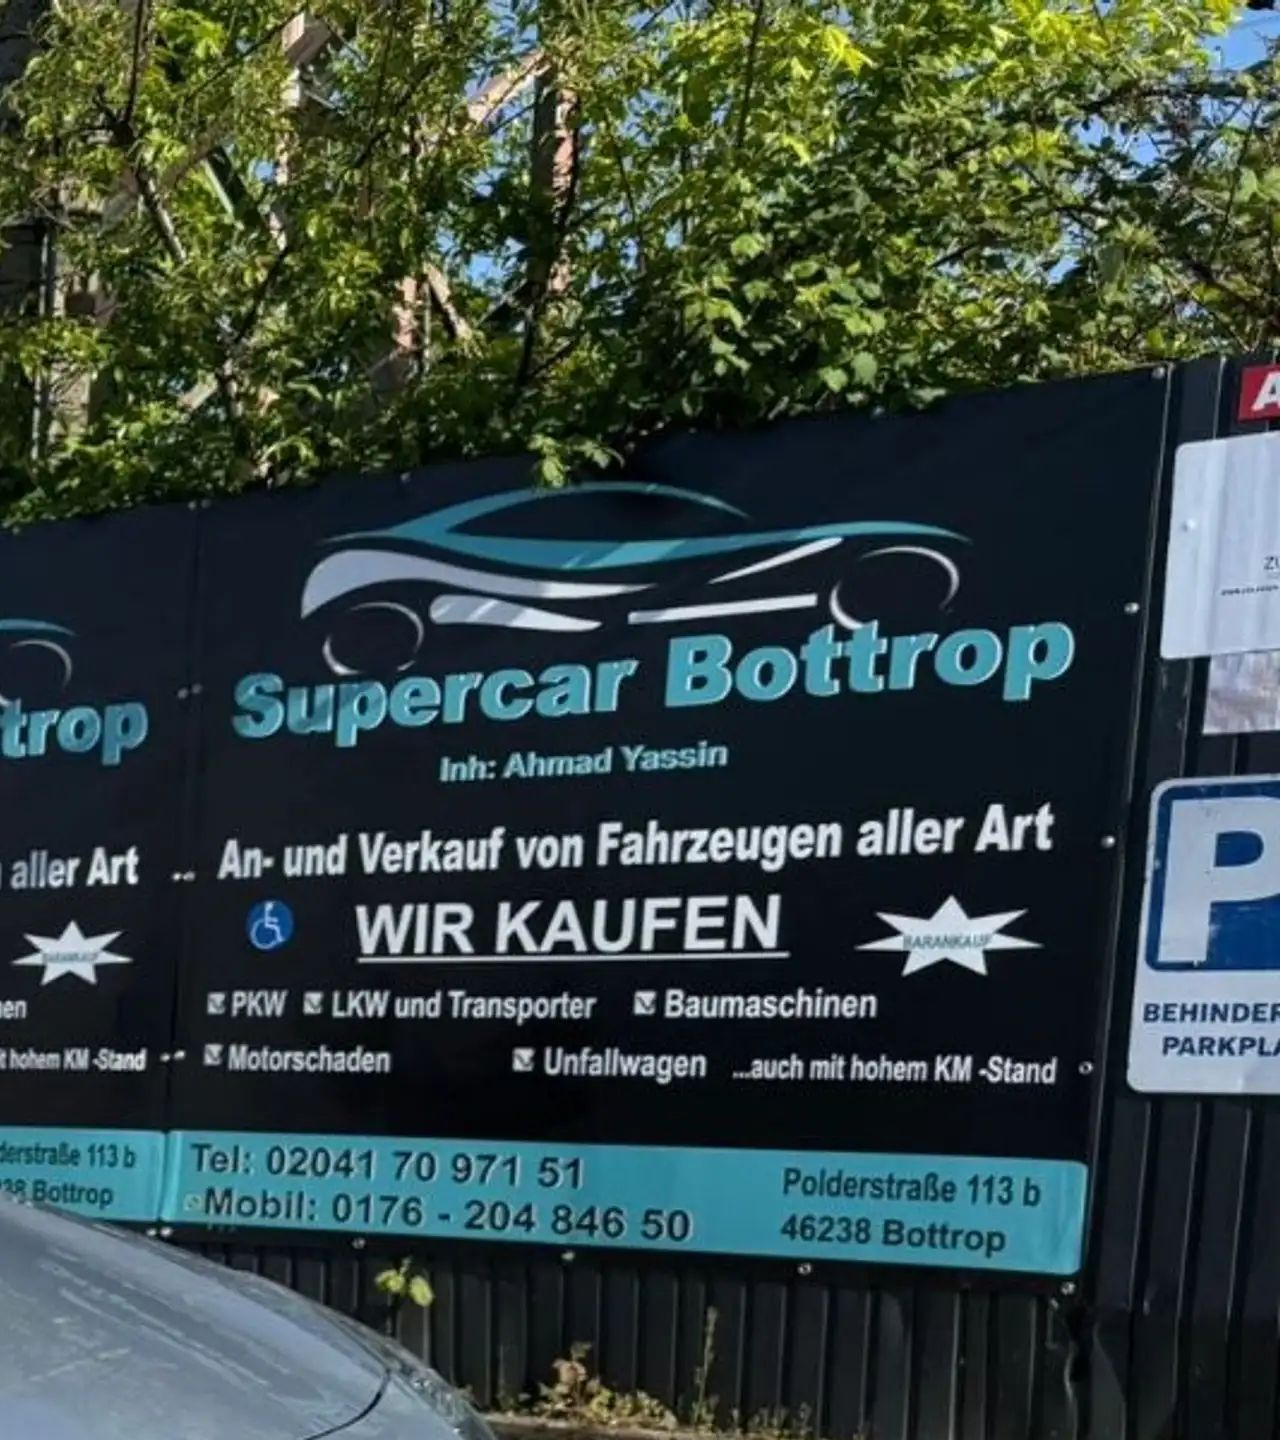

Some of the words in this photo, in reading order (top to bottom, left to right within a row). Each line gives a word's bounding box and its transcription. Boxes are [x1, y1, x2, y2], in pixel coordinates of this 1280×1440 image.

[232, 659, 639, 748] Supercar
[665, 619, 1075, 708] Bottrop
[439, 756, 496, 783] Inh:
[503, 746, 612, 779] Ahmad
[620, 740, 728, 772] Yassin
[217, 838, 274, 880] An-
[283, 833, 348, 877] und
[358, 826, 507, 873] Verkauf
[516, 833, 583, 869] von
[597, 811, 841, 872] Fahrzeugen
[856, 807, 966, 856] aller
[974, 801, 1056, 853] Art
[10, 850, 81, 889] aller
[86, 846, 139, 885] Art
[1157, 797, 1280, 963] P
[355, 903, 474, 955] WIR
[495, 893, 781, 954] KAUFEN
[231, 991, 287, 1017] PKW
[331, 992, 391, 1018] LKW
[394, 991, 441, 1018] und
[447, 991, 598, 1026] Transporter
[664, 987, 878, 1019] Baumaschinen
[9, 1048, 61, 1070] hohem
[63, 1049, 89, 1070] KM
[227, 1044, 391, 1073] Motorschaden
[543, 1048, 707, 1084] Unfallwagen
[732, 1054, 803, 1080] ...auch
[809, 1054, 845, 1081] mit
[850, 1054, 928, 1082] hohem
[933, 1055, 973, 1082] KM
[978, 1055, 1058, 1084] -Stand
[88, 1143, 117, 1168] 113
[123, 1148, 136, 1169] b
[190, 1142, 252, 1176] Tel:
[266, 1145, 375, 1180] 02041
[392, 1149, 436, 1183] 70
[450, 1152, 521, 1187] 971
[537, 1156, 584, 1190] 51
[32, 1180, 114, 1210] Bottrop
[782, 1167, 957, 1203] Polderstraße
[967, 1174, 1013, 1206] 113
[1023, 1177, 1041, 1206] b
[204, 1186, 316, 1222] Mobil:
[331, 1193, 423, 1227] 0176
[463, 1199, 536, 1233] 204
[550, 1204, 626, 1239] 846
[641, 1207, 691, 1242] 50
[781, 1214, 871, 1245] 46238
[882, 1219, 1005, 1257] Bottrop
